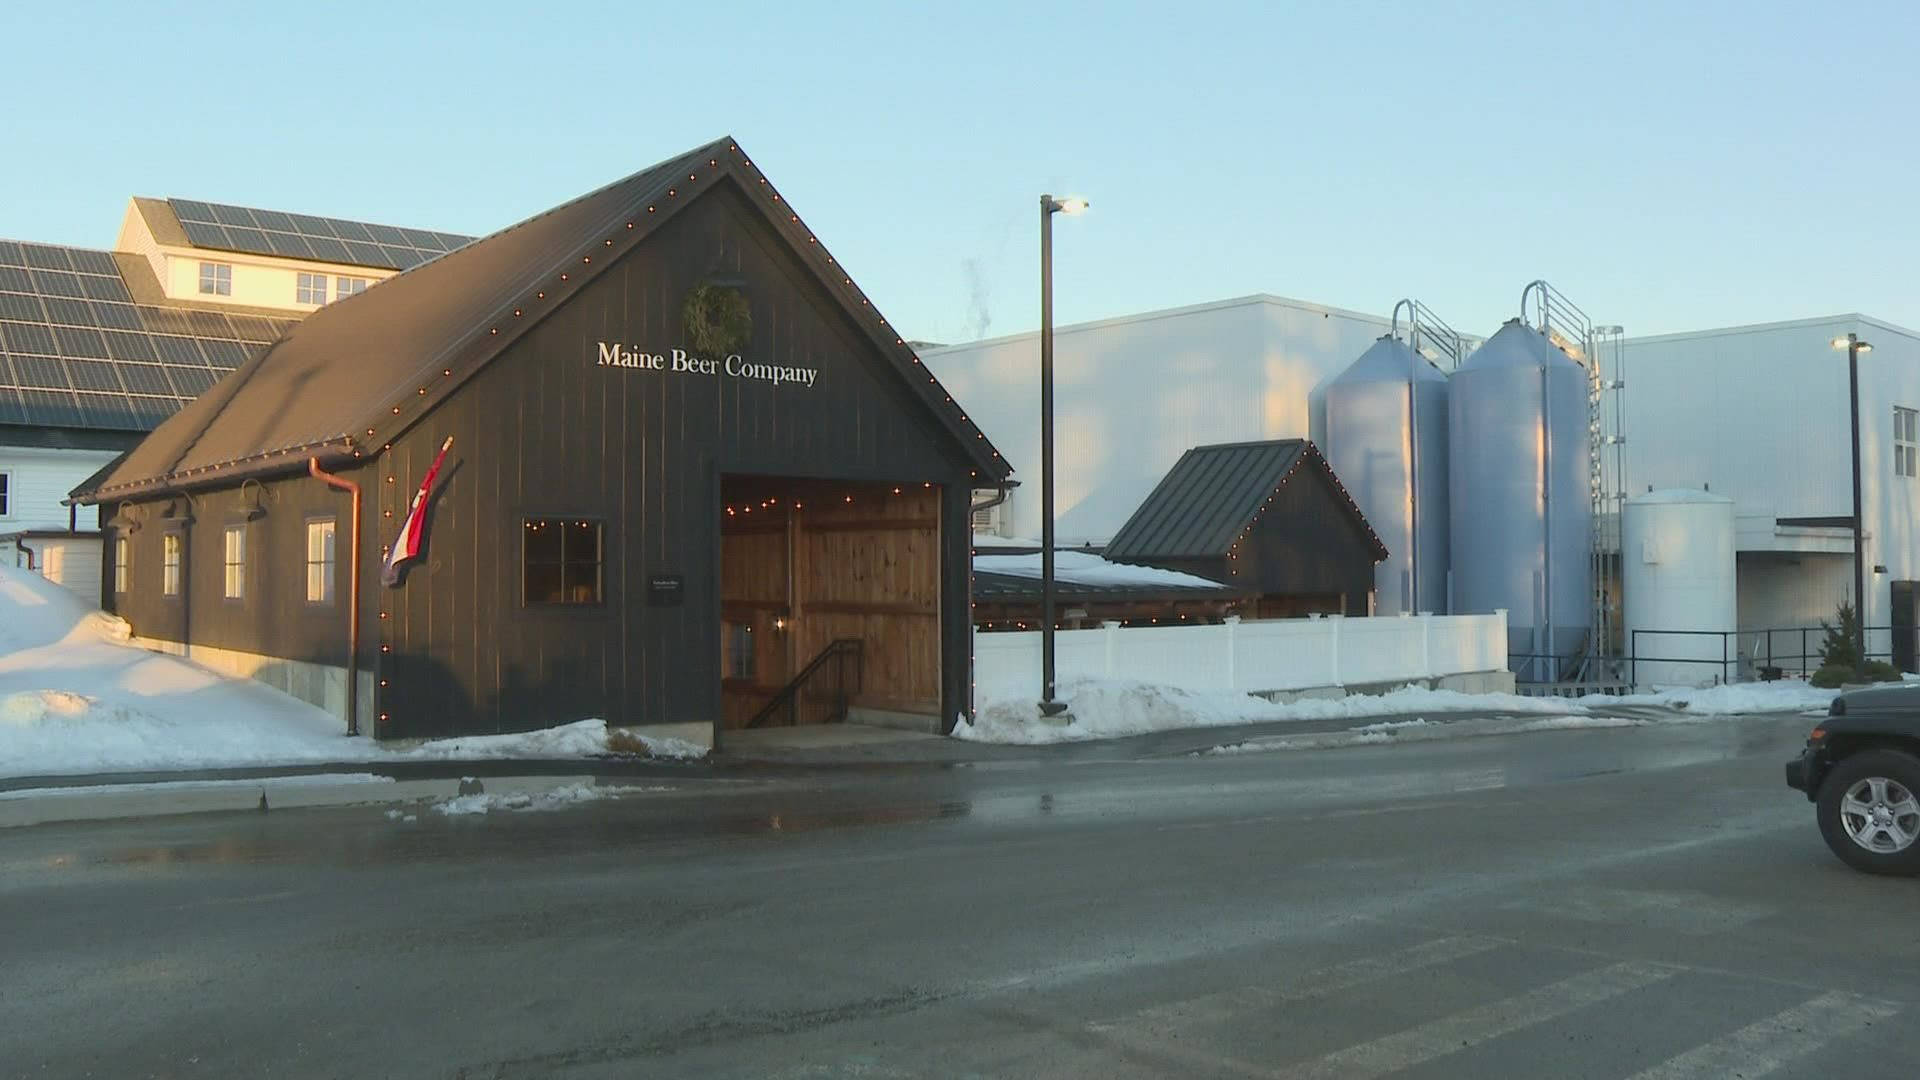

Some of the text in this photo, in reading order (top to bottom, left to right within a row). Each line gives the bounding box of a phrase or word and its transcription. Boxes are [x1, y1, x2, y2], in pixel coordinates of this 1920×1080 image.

[597, 342, 818, 387] Maine Beer Company
